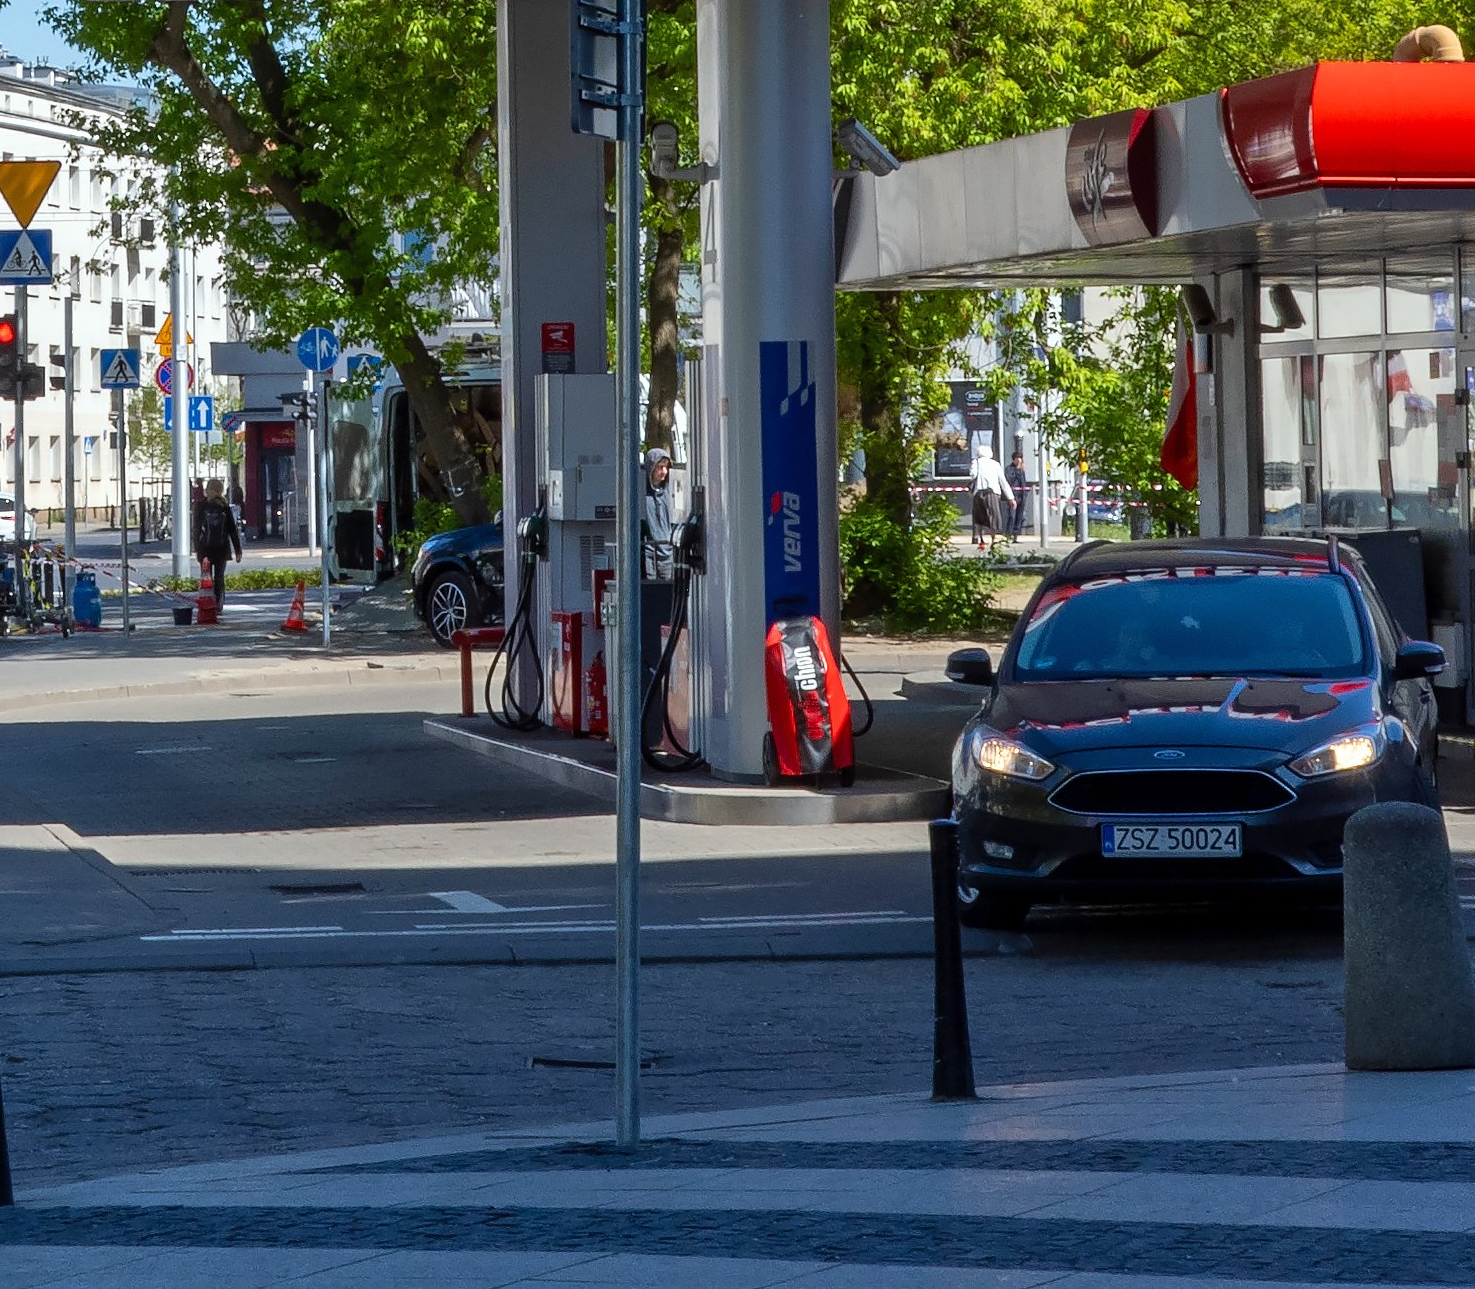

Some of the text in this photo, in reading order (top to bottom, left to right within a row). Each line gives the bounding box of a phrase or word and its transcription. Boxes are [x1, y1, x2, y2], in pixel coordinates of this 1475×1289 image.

[782, 491, 802, 573] verva
[1116, 828, 1238, 850] ZSZ 50024
